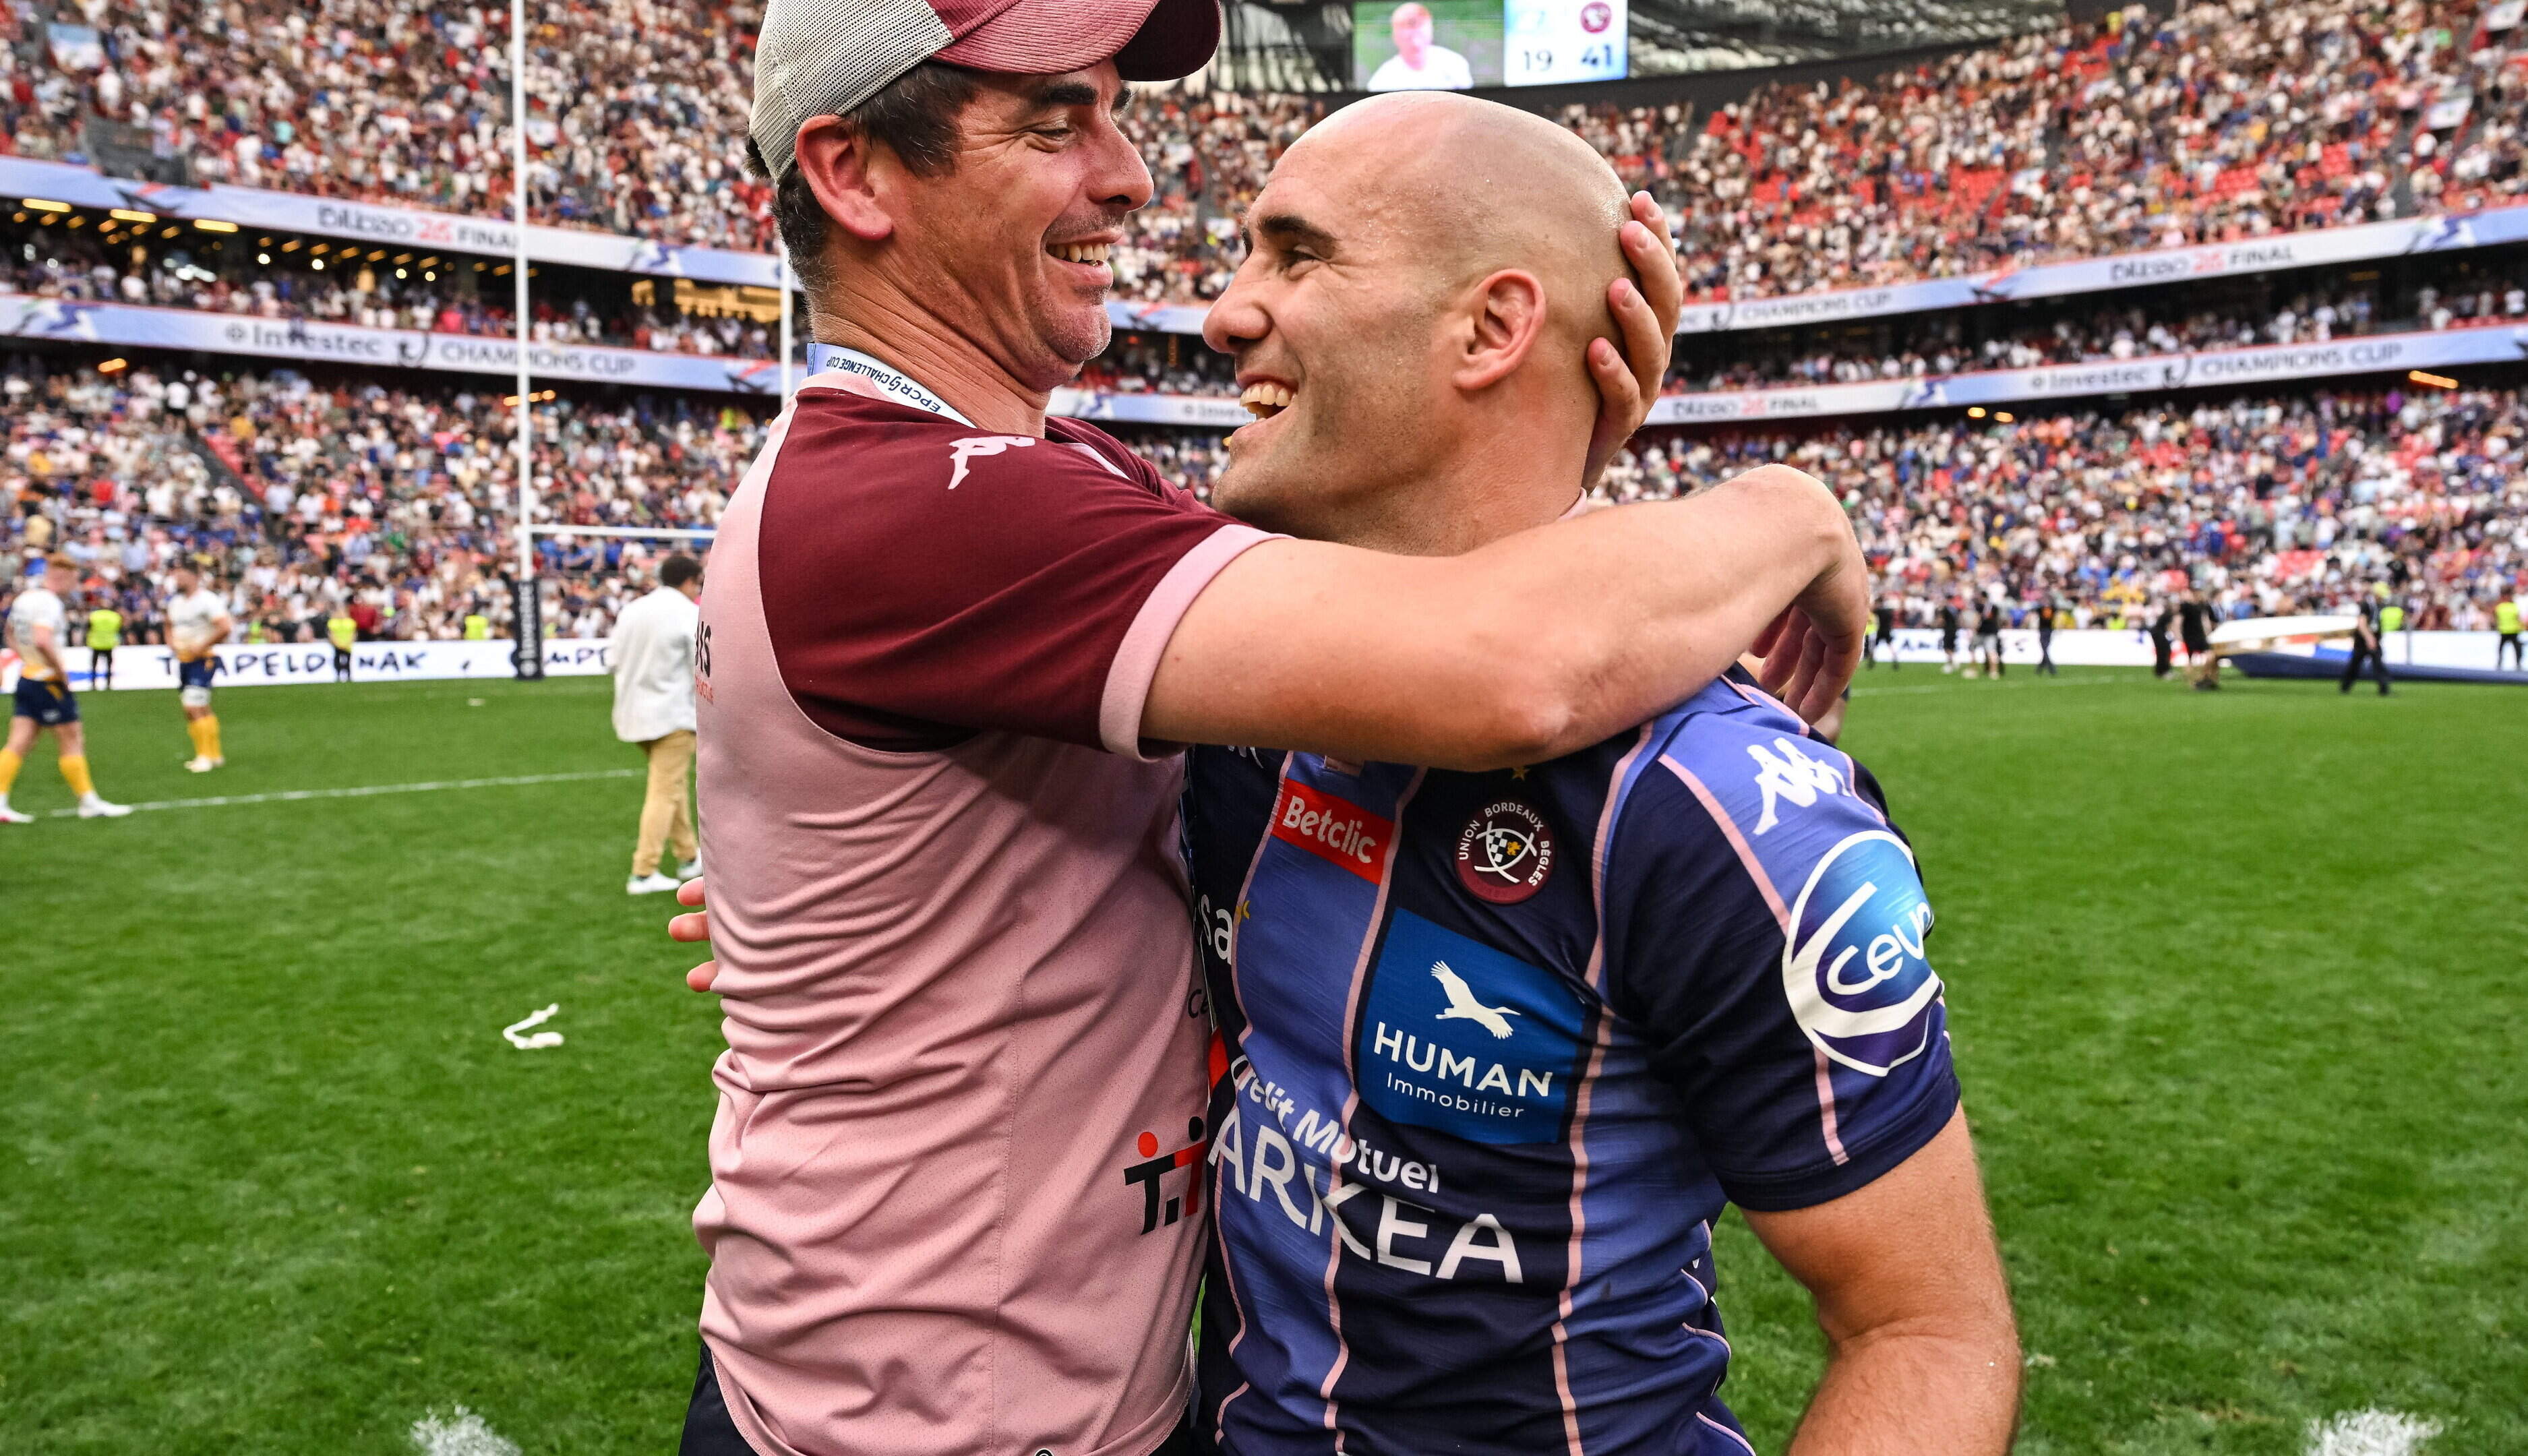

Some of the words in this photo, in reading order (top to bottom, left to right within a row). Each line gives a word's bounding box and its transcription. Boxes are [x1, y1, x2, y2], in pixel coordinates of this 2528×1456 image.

[1524, 49, 1553, 71] 19
[1582, 44, 1612, 67] 41
[589, 353, 636, 375] CUP
[826, 356, 840, 367] CUP
[2350, 342, 2403, 363] CUP
[839, 359, 891, 384] CHALLENGE
[900, 384, 941, 413] EPCR
[1283, 795, 1376, 863] Betclic
[1459, 820, 1480, 860] UNION
[1484, 802, 1544, 832] BORDEAUX
[1374, 1021, 1553, 1097] HUMAN
[1387, 1072, 1525, 1118] Immobilier
[1292, 1109, 1439, 1194] Mutuel
[1207, 1108, 1524, 1283] ARKEA
